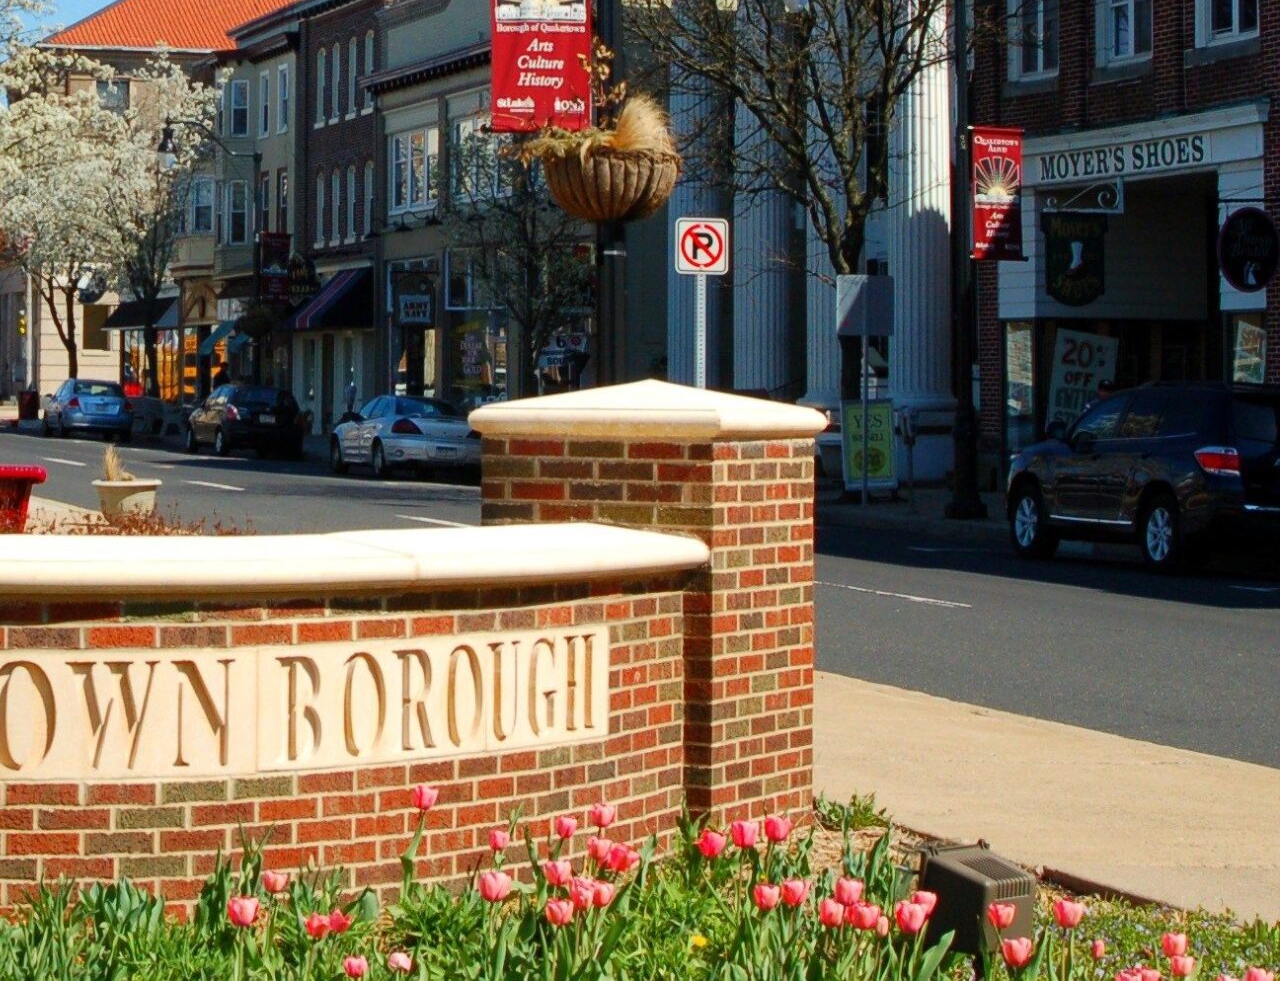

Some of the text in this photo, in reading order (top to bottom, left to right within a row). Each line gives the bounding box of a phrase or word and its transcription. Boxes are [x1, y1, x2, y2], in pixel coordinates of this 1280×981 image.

[496, 23, 586, 34] Borough of Quakertown
[527, 38, 554, 53] Arts
[517, 55, 565, 71] Culture
[517, 72, 564, 90] History
[1040, 135, 1204, 181] MOYER'S SHOES
[1063, 370, 1094, 388] OFF
[274, 633, 598, 762] BOROUGH
